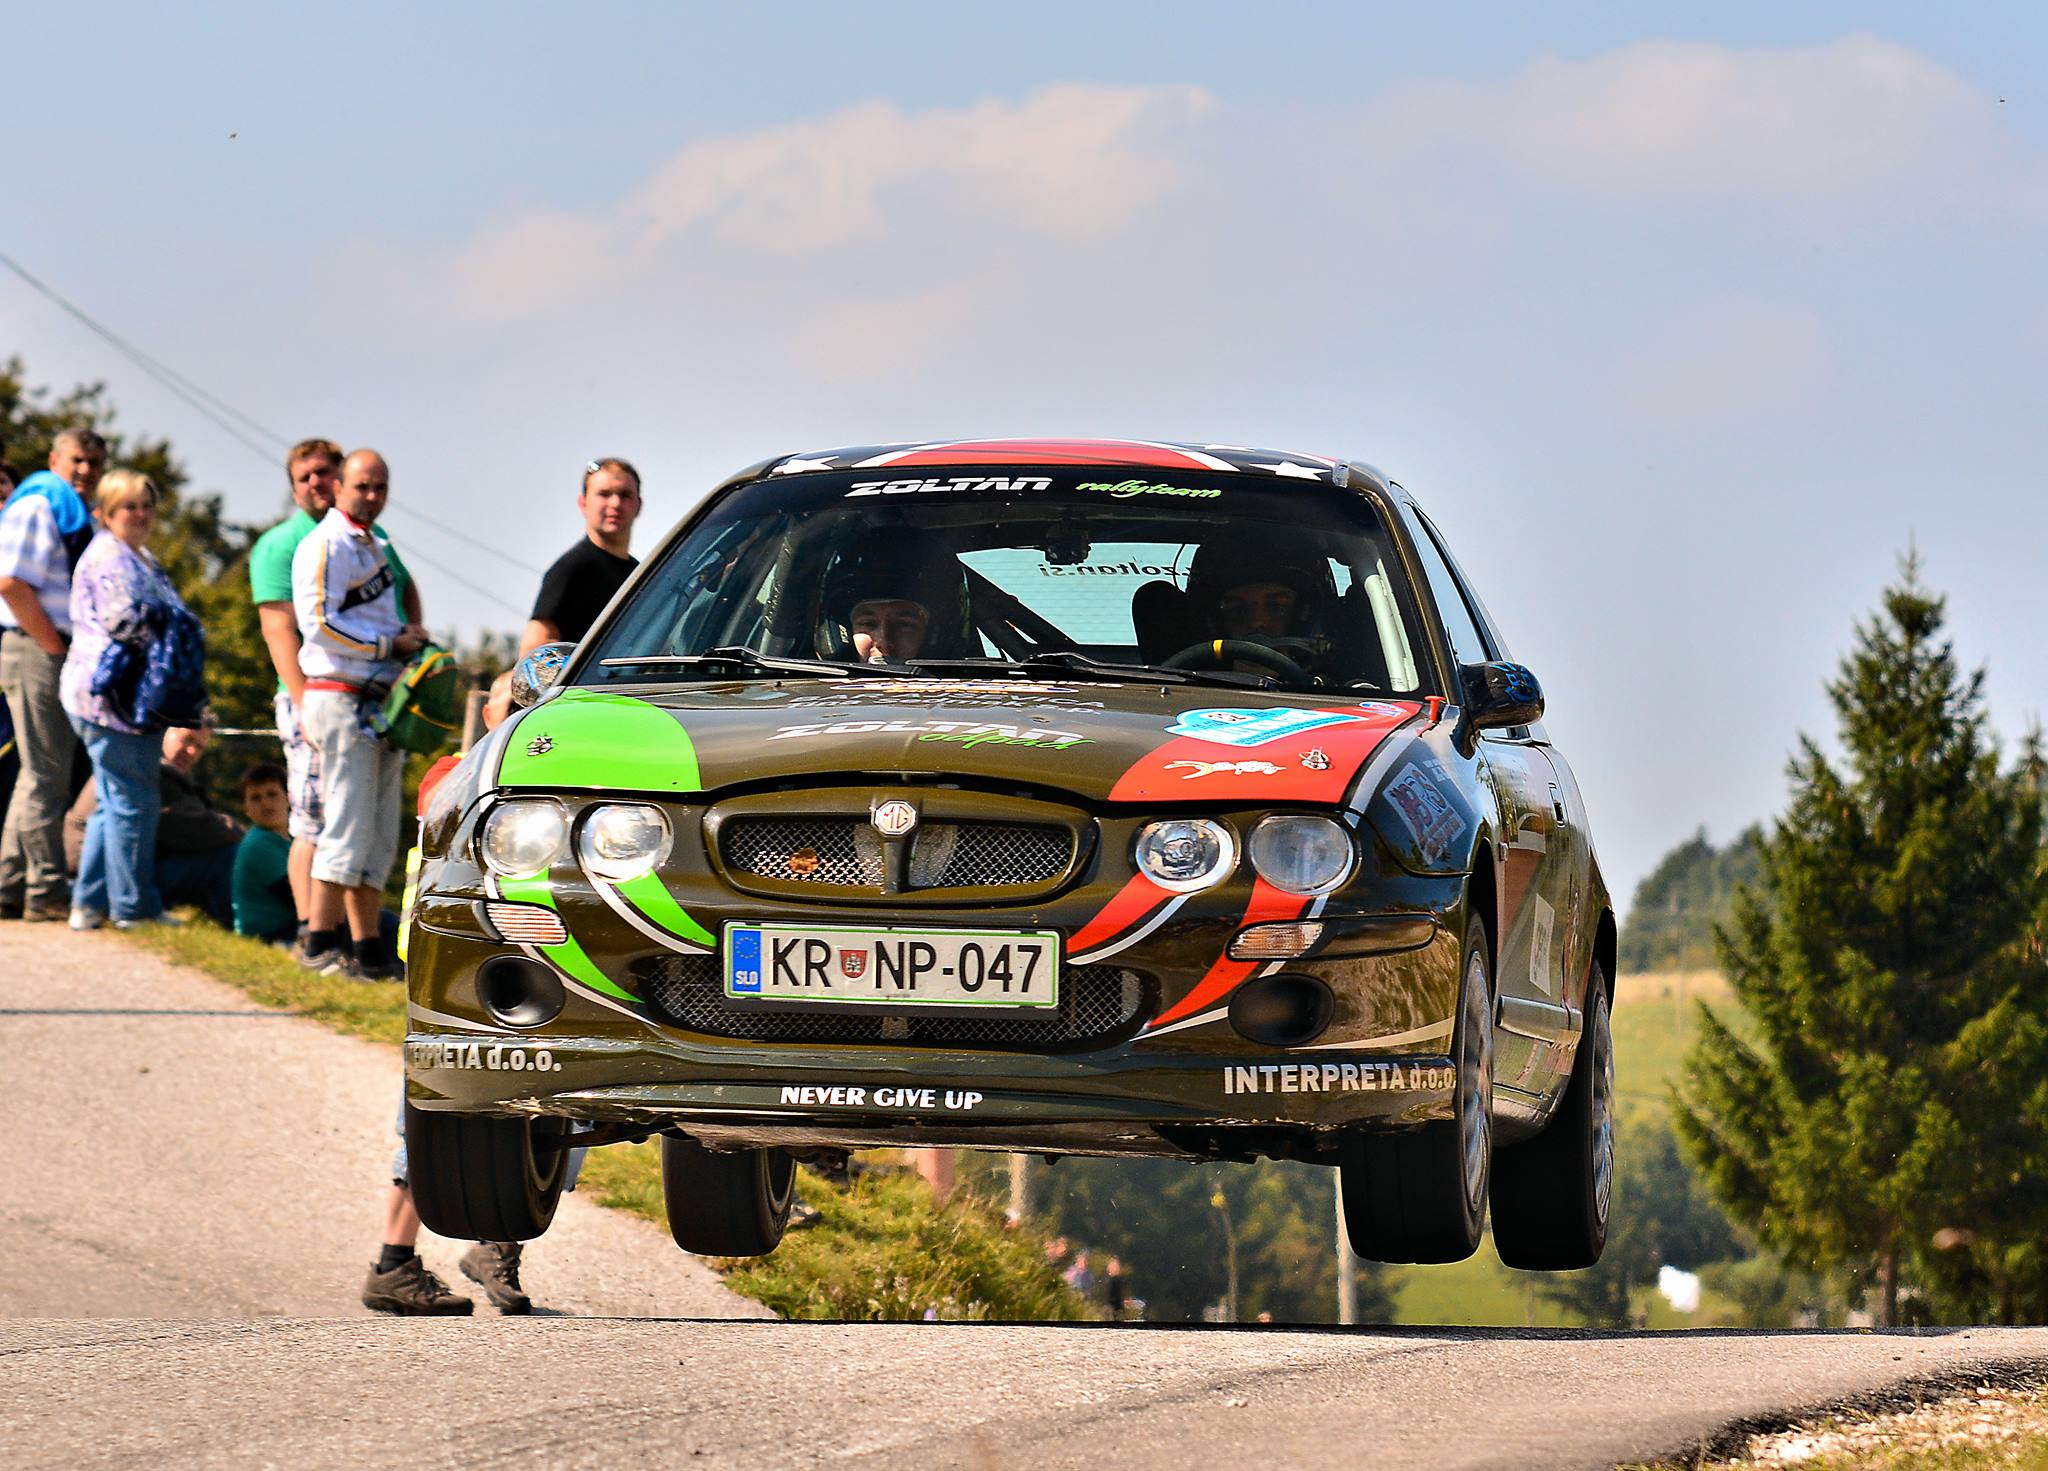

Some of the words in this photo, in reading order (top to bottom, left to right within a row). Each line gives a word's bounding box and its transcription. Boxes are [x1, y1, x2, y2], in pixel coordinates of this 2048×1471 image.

[844, 476, 1052, 498] ZOLTAN
[1075, 479, 1222, 500] rallyteam
[766, 720, 1084, 742] ZOLTAN
[876, 803, 912, 831] MG
[735, 970, 759, 987] SLO
[771, 937, 832, 988] KR
[875, 941, 1043, 994] NP-047
[486, 1043, 563, 1072] d.o.o.
[1223, 1062, 1406, 1095] INTERPRETA
[779, 1085, 866, 1107] NEVER
[873, 1088, 936, 1110] GIVE
[943, 1090, 984, 1111] UP
